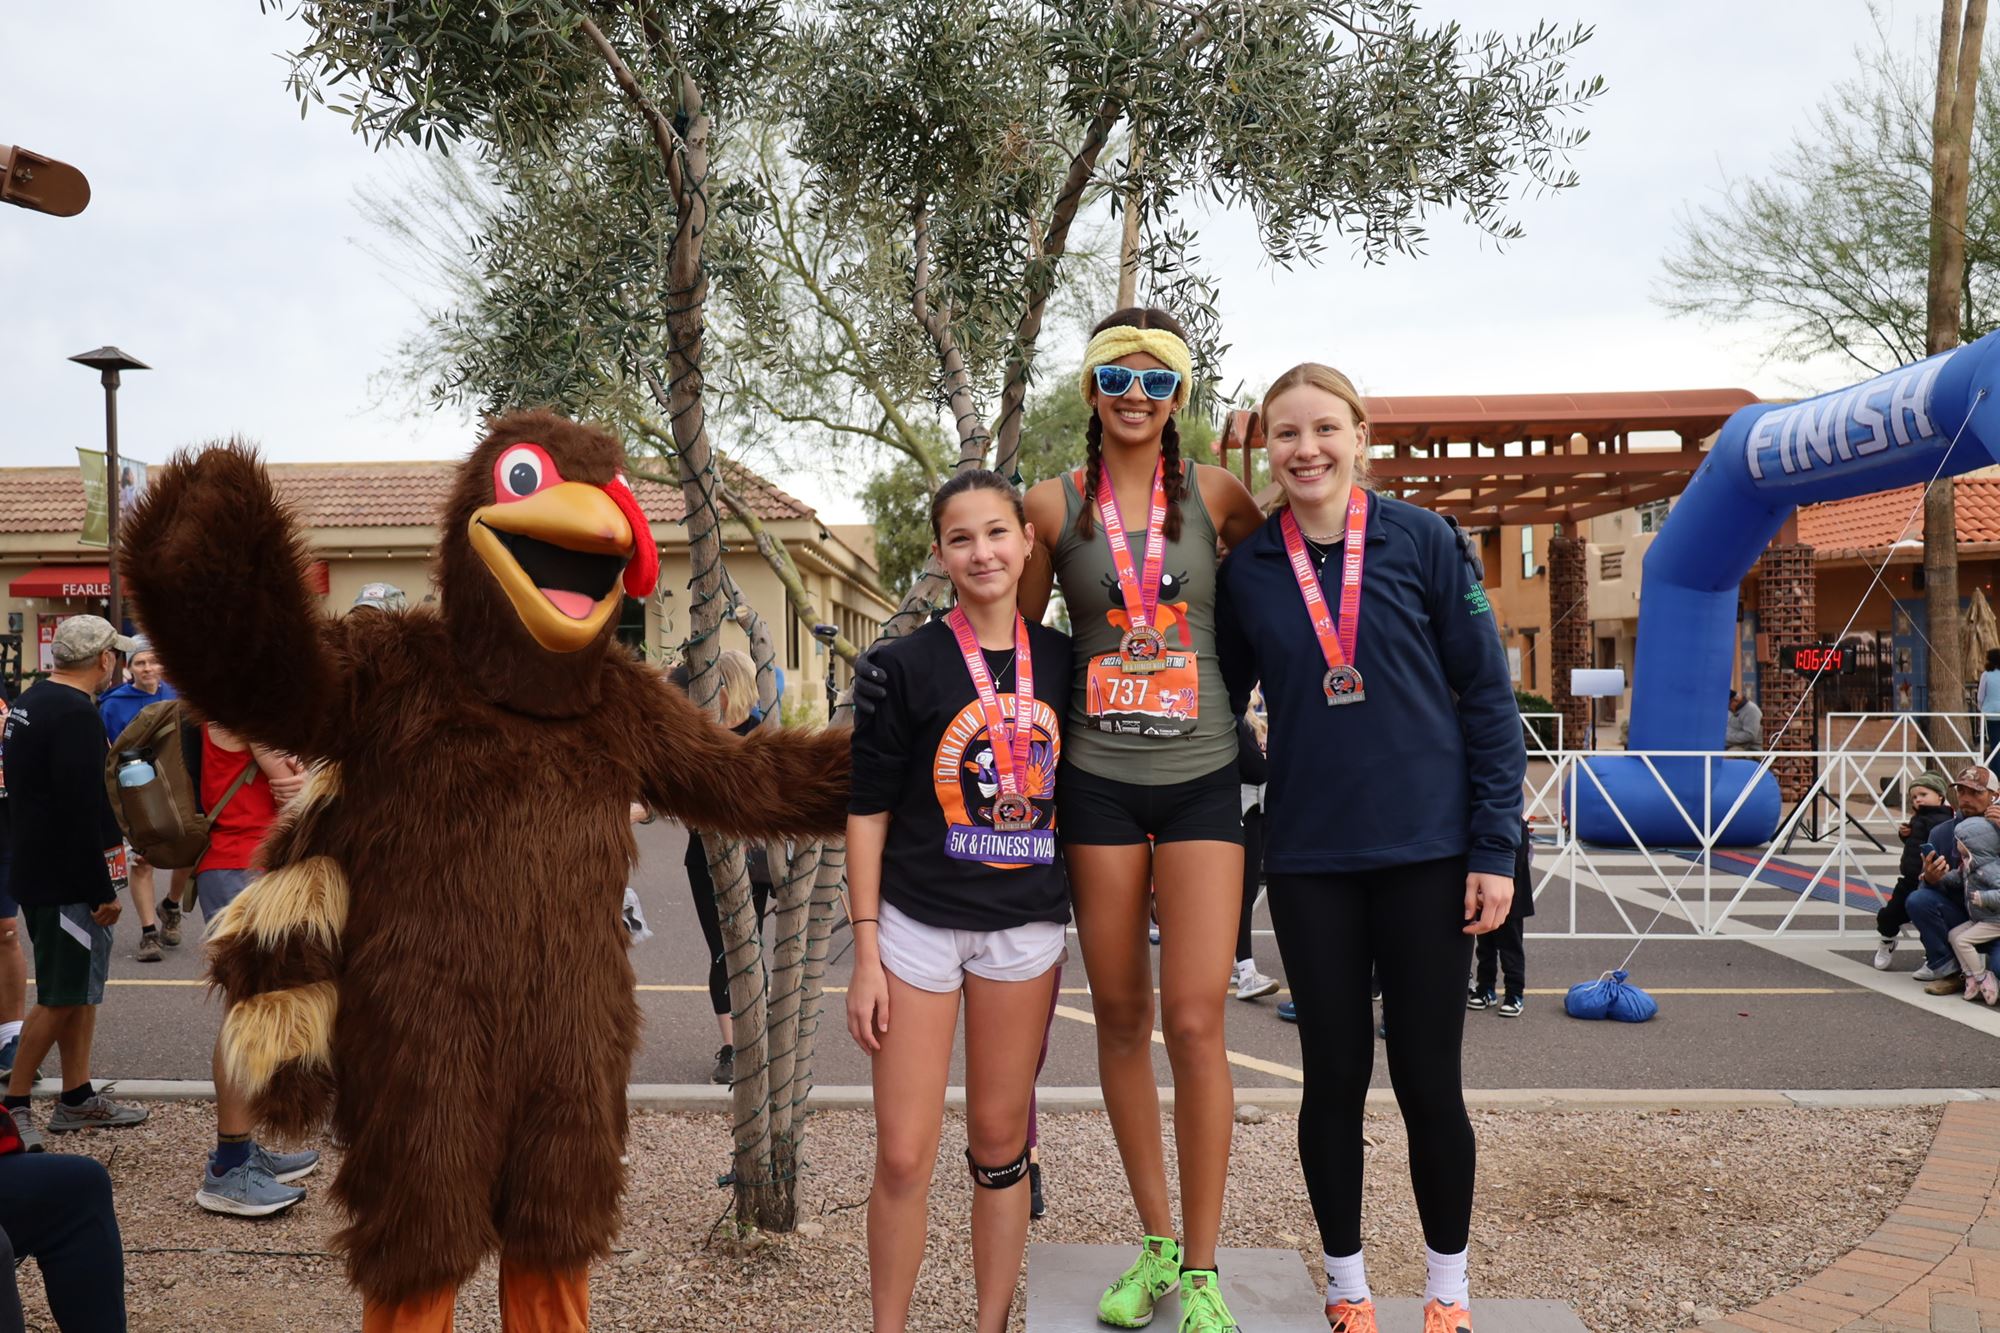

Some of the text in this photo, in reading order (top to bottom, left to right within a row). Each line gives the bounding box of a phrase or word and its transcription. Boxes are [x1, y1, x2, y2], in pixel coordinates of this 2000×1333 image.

[1747, 367, 1936, 479] FINISH
[1101, 501, 1121, 530] TURKEY
[1151, 505, 1166, 525] TROT
[1110, 532, 1127, 552] TROT
[1147, 527, 1164, 558] TURKEY
[1347, 529, 1362, 549] TROT
[1291, 550, 1314, 582] TURKEY
[1303, 582, 1321, 605] TROT
[1344, 553, 1361, 586] TURKEY
[1131, 615, 1148, 627] 20
[966, 651, 989, 683] TURKEY
[979, 685, 997, 707] TROT
[1018, 677, 1032, 697] TROT
[1107, 678, 1149, 705] 737
[1017, 699, 1032, 733] TURKEY
[1032, 702, 1060, 745] URKEY
[937, 710, 980, 783] FOUNTAIN
[951, 831, 1056, 858] 5K & FITNESS WAL
